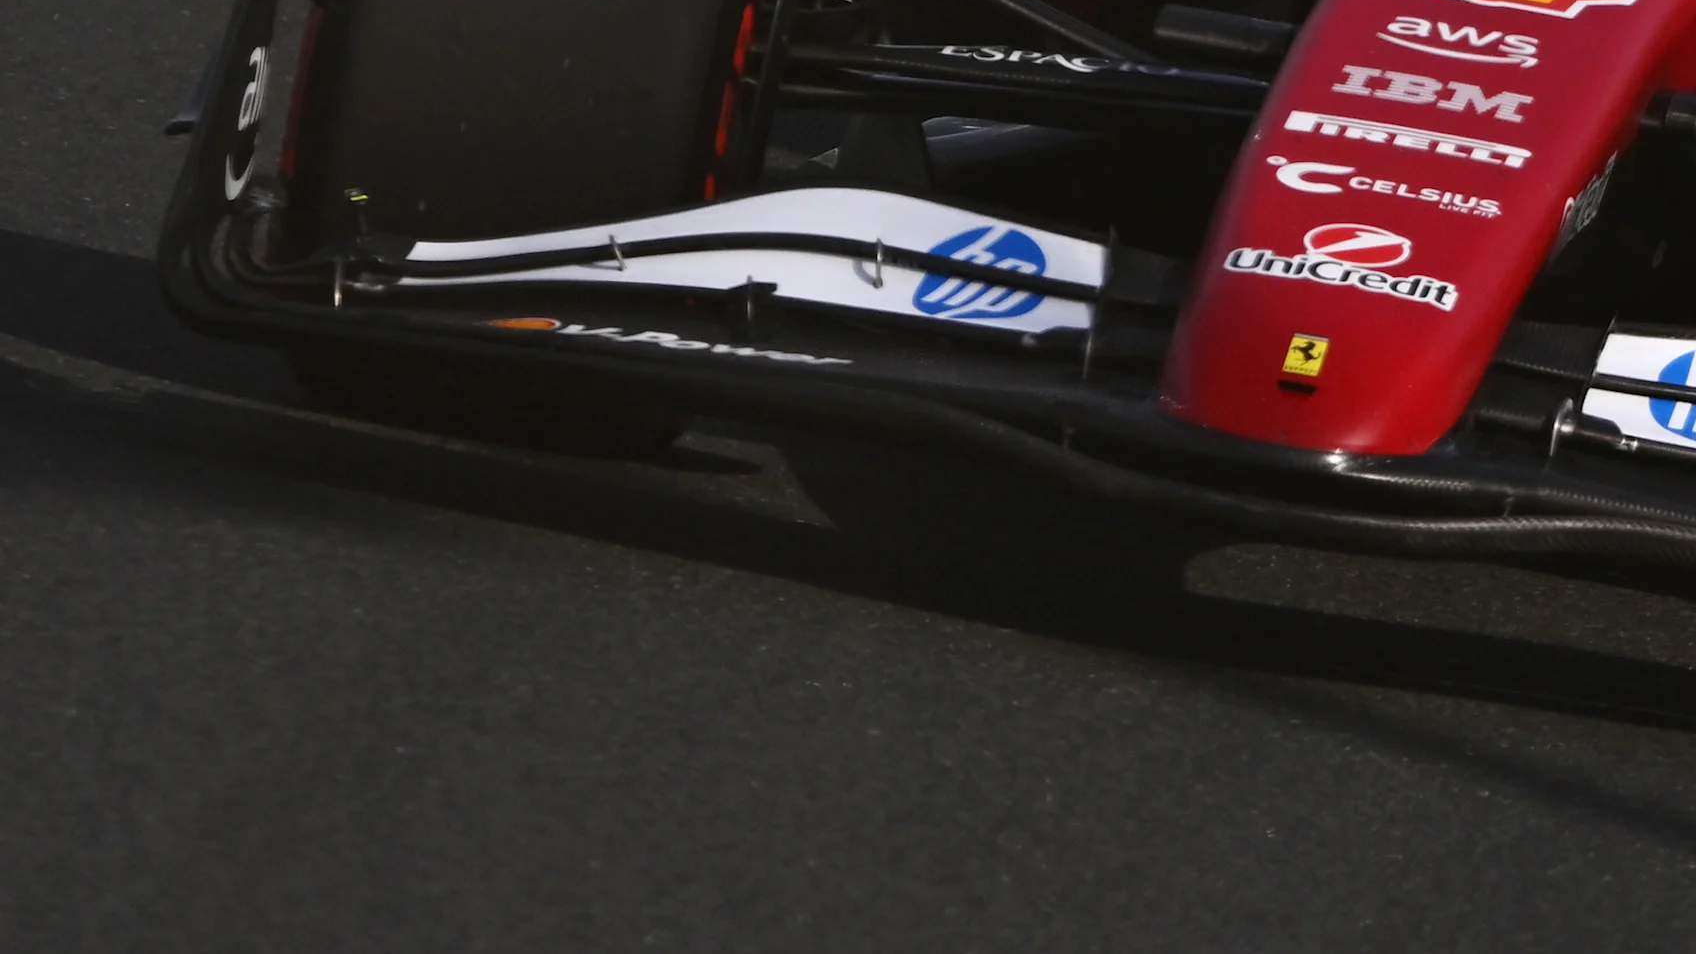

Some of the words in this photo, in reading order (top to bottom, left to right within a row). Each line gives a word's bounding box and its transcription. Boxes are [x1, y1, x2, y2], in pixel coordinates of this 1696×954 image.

[1386, 14, 1540, 57] aws
[1331, 64, 1534, 124] IBM
[1283, 109, 1533, 169] PIRELLI
[918, 225, 1042, 320] hp
[1225, 248, 1458, 310] UniCredit
[557, 322, 853, 365] V-Power
